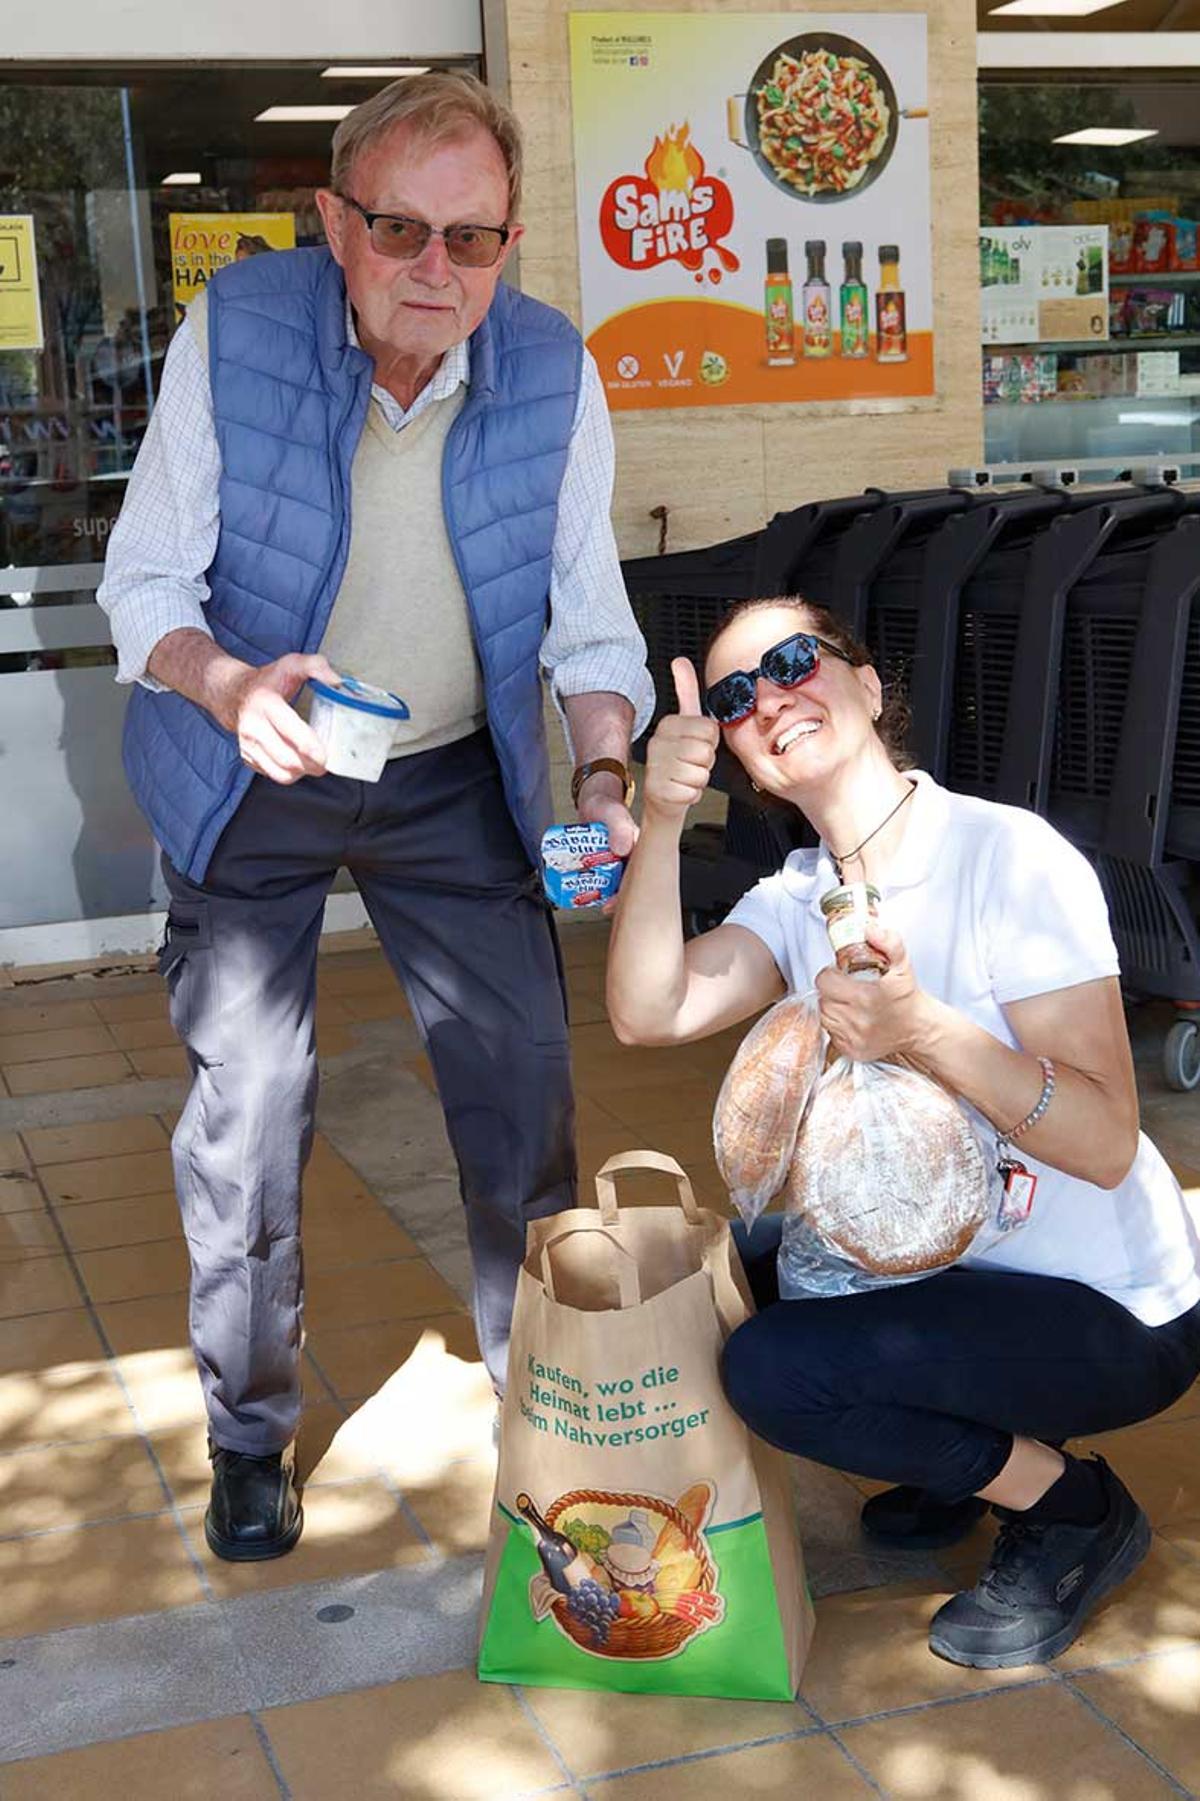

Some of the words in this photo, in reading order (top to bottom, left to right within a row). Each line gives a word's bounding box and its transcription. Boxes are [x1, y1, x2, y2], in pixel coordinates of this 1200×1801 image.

[615, 176, 714, 230] Sam's
[174, 223, 231, 250] love
[174, 253, 187, 266] is
[191, 252, 204, 265] in
[209, 252, 232, 265] the
[596, 1378, 634, 1397] wo
[641, 1366, 679, 1389] die
[530, 1381, 592, 1421] Heimat
[597, 1400, 646, 1422] lebt
[554, 1409, 710, 1447] Nahversorger
